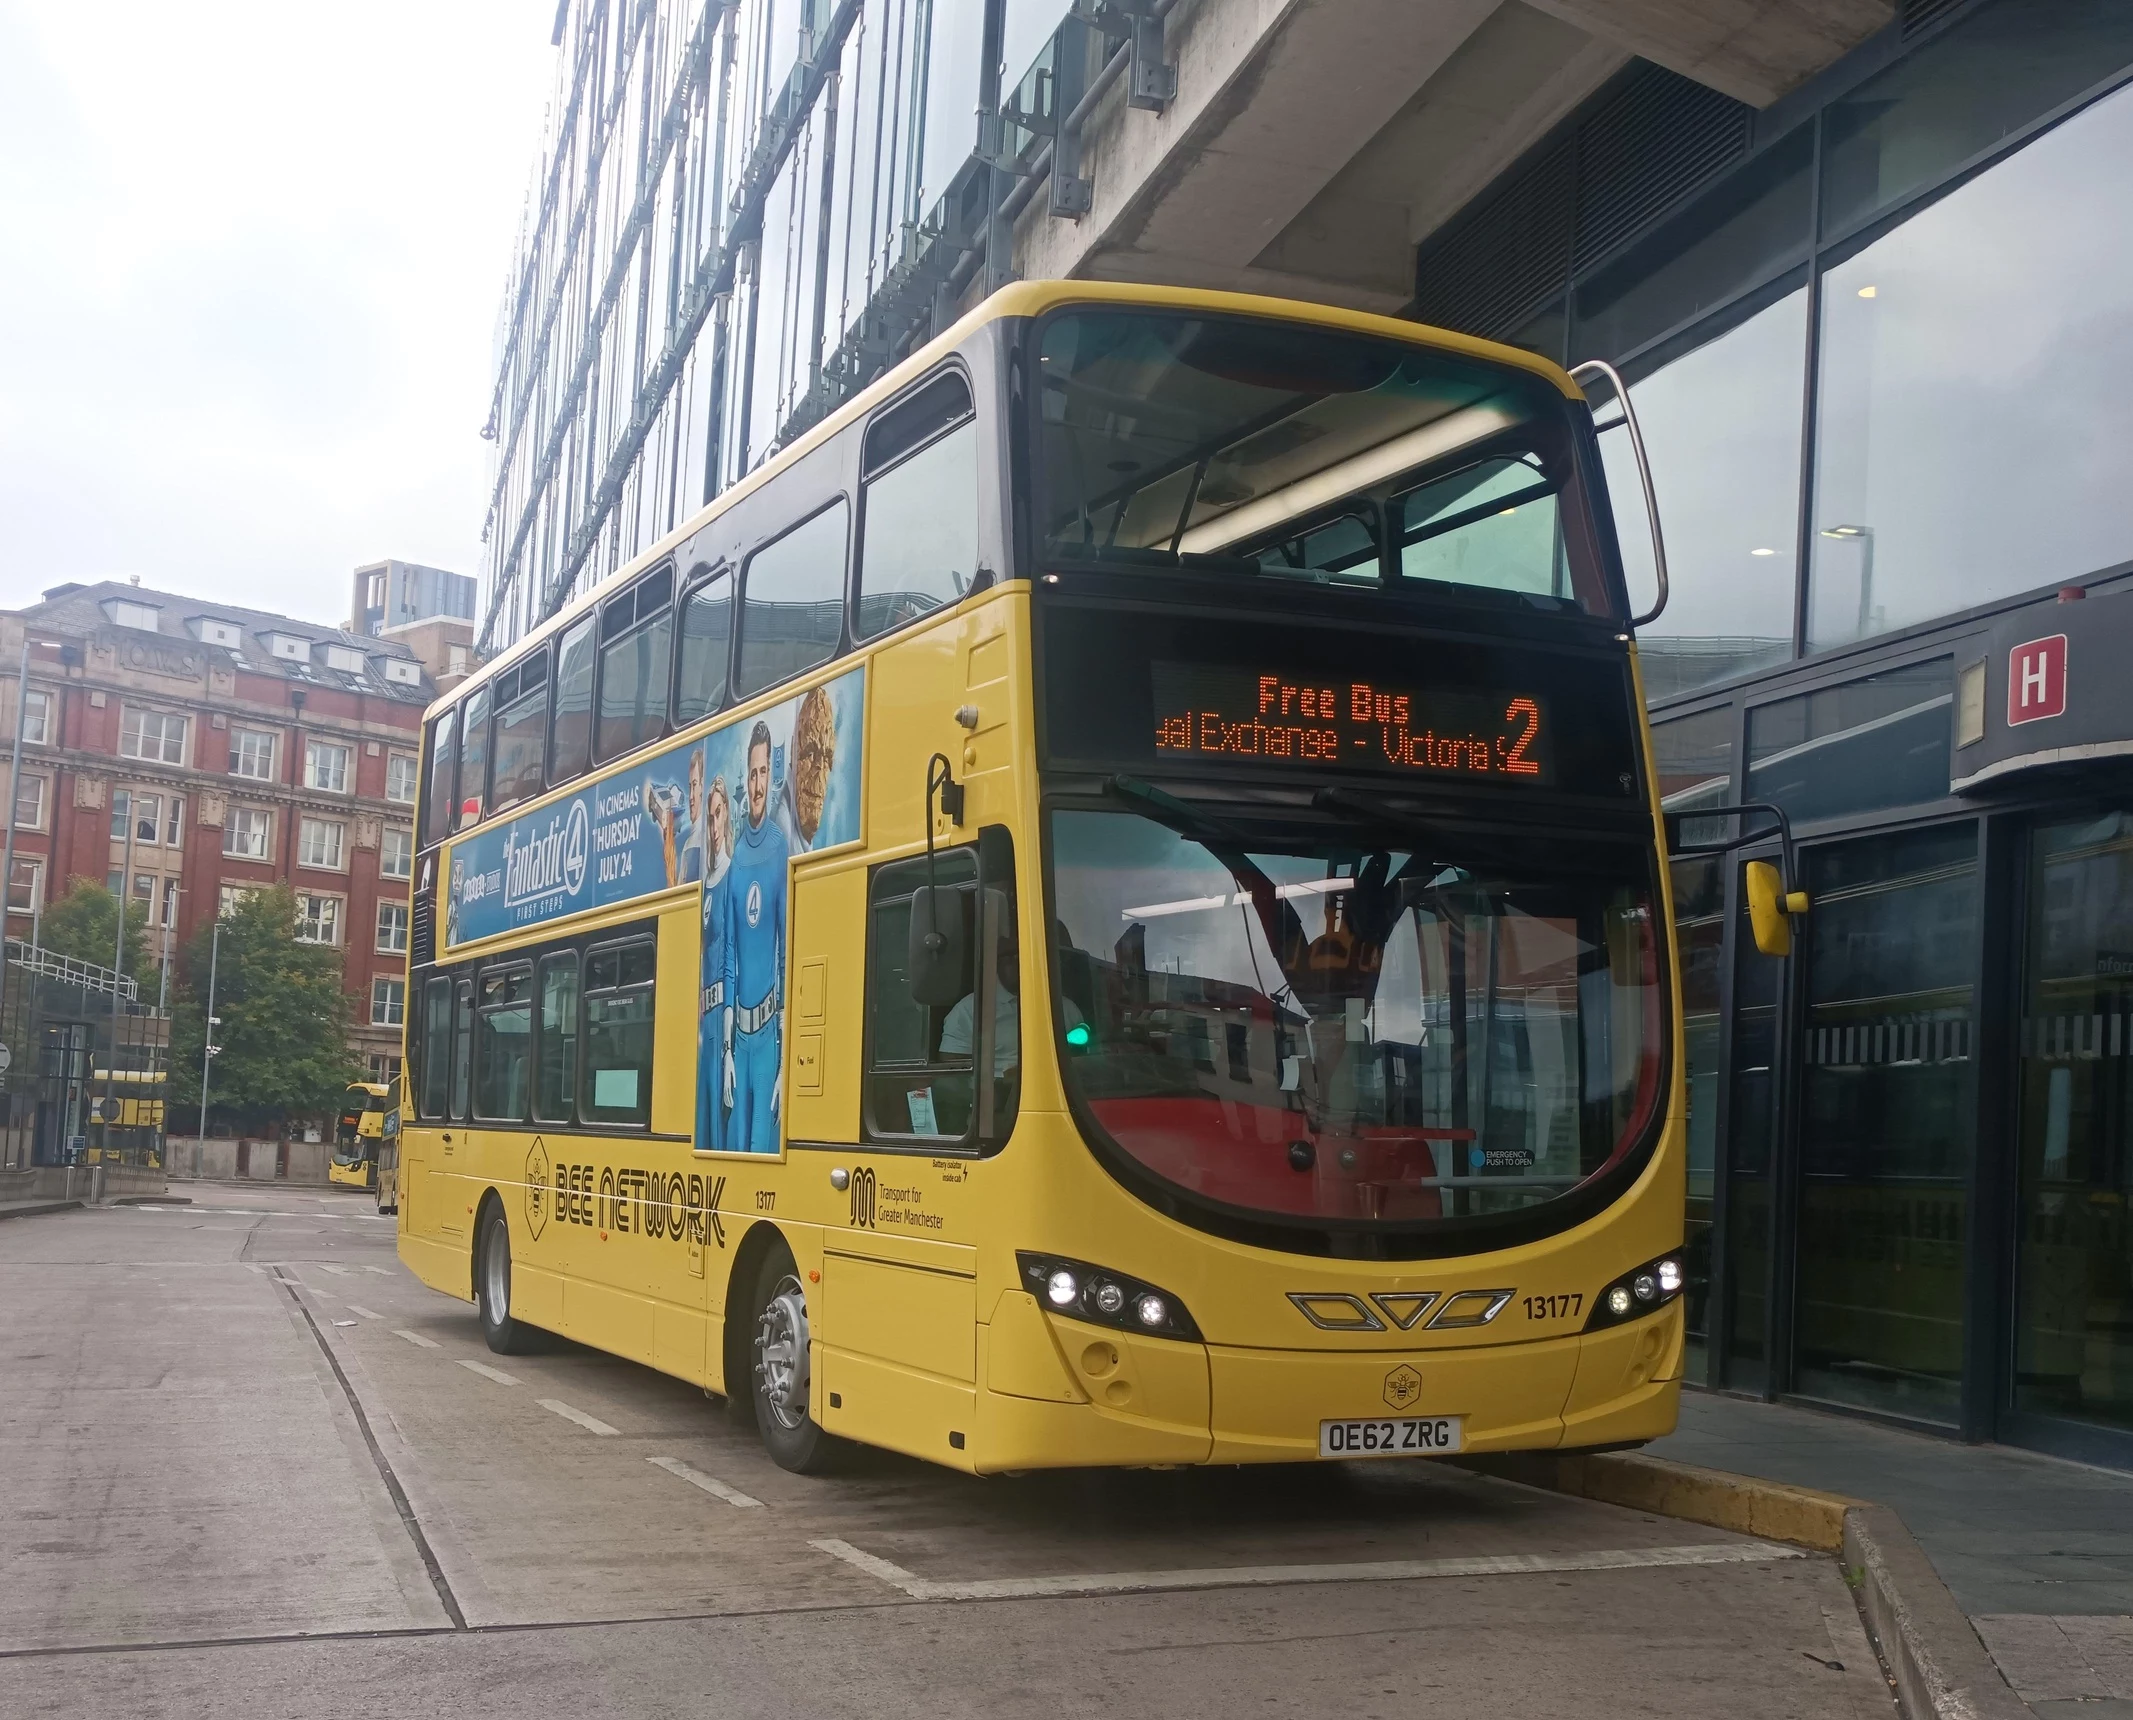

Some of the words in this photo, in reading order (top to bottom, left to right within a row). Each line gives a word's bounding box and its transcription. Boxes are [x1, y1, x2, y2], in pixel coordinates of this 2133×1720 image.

[2021, 651, 2047, 708] H
[1259, 676, 1335, 718] Free
[1351, 684, 1409, 724] Bus
[1201, 712, 1337, 759] Exchange
[1383, 727, 1488, 769] Victoria
[1506, 698, 1539, 774] 2
[596, 798, 605, 819] IN
[606, 785, 639, 817] CINEMAS
[592, 813, 642, 852] THURSDAY
[598, 853, 620, 884] JULY
[620, 849, 632, 877] 24
[516, 902, 537, 921] FIRST
[540, 894, 563, 915] STEPS
[1486, 1150, 1527, 1159] EMERGENCY
[1486, 1158, 1504, 1166] PUSH
[1505, 1158, 1514, 1166] TO
[1514, 1158, 1533, 1166] OPEN
[555, 1163, 594, 1227] BEE
[598, 1166, 727, 1249] NETWORK
[755, 1190, 776, 1211] 13177
[879, 1183, 910, 1205] Transport
[911, 1186, 922, 1203] for
[878, 1205, 903, 1224] Greater
[904, 1208, 944, 1229] Manchester
[1522, 1293, 1583, 1320] 13177
[1329, 1422, 1395, 1451] OE62
[1401, 1420, 1449, 1449] ZRG
